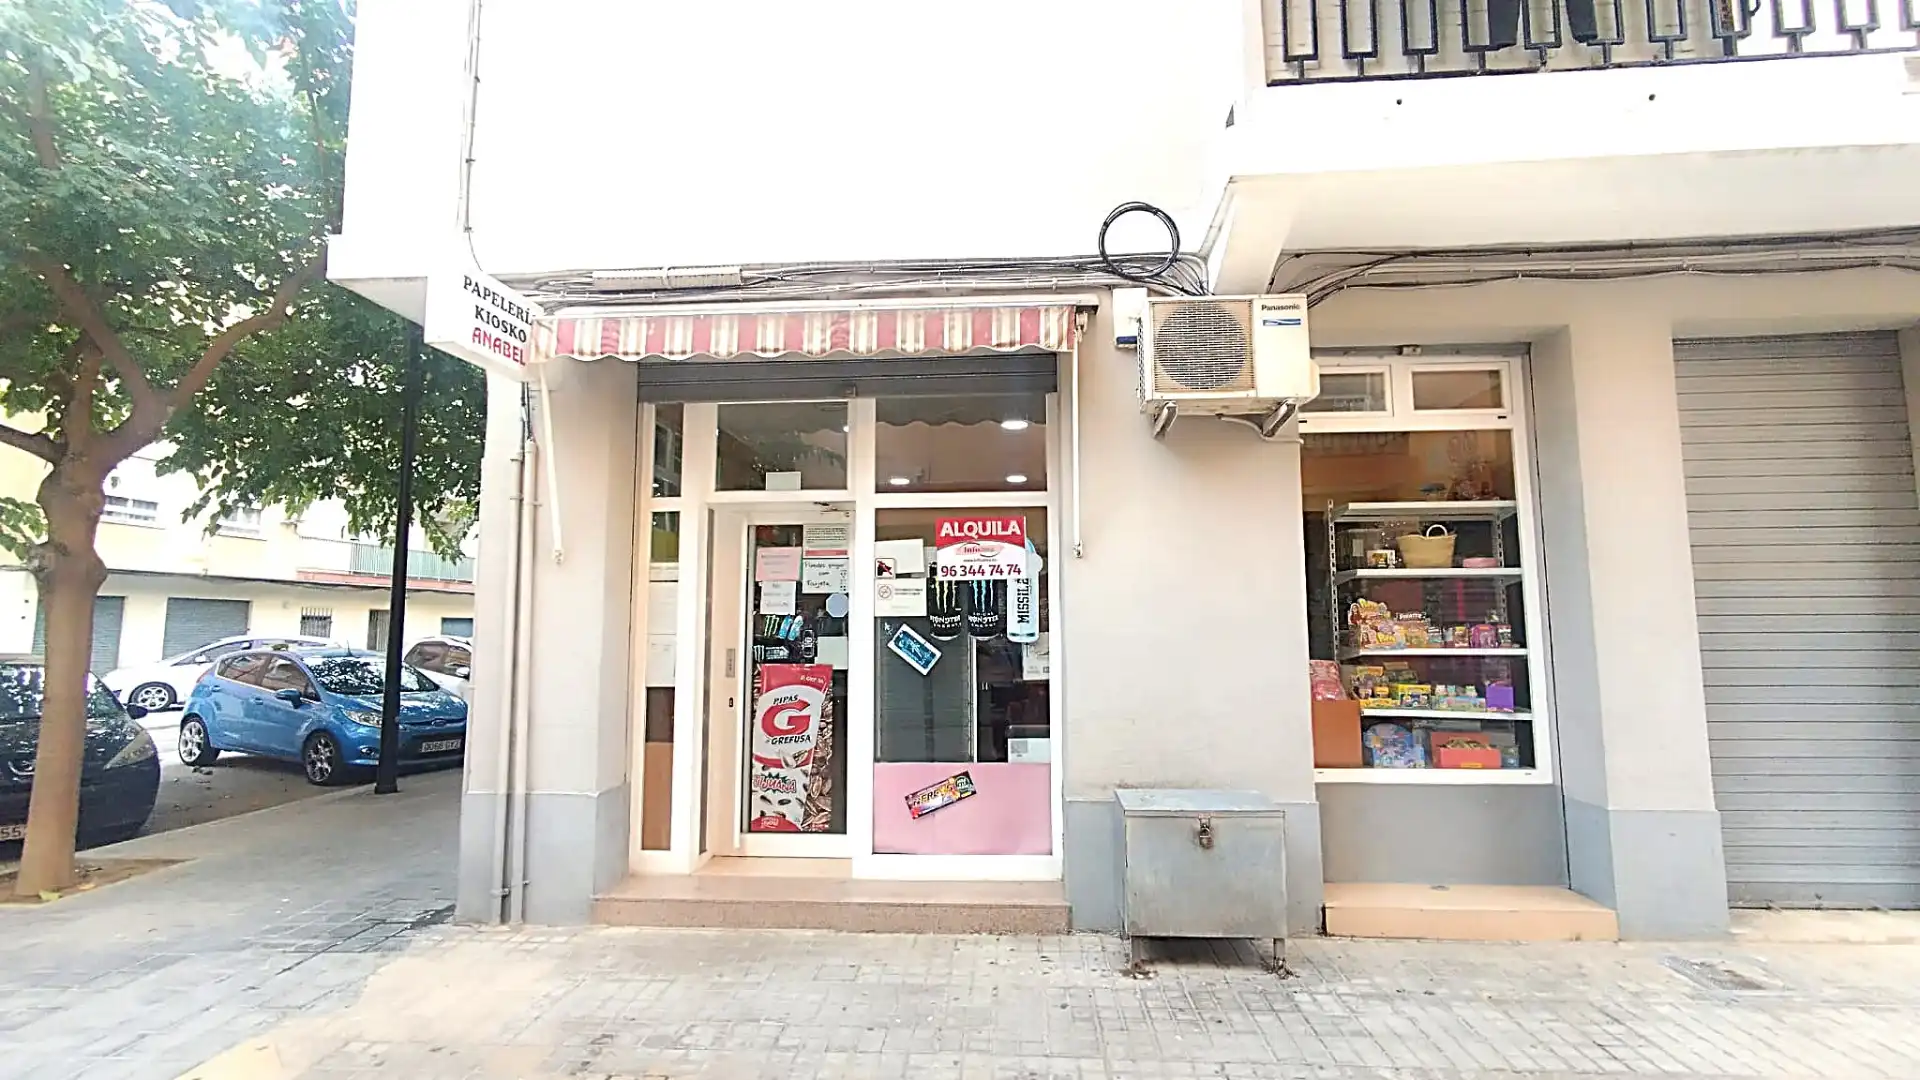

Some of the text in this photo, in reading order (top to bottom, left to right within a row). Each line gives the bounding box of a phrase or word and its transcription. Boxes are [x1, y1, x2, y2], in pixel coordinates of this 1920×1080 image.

[463, 275, 535, 326] PAPELERÍ
[475, 305, 527, 343] KIOSKO
[472, 327, 526, 366] ANABEL
[940, 520, 1021, 538] ALQUILA
[941, 563, 1022, 577] 96 344 74 74
[930, 614, 961, 624] MONSTER
[968, 614, 999, 624] MONSTER
[772, 694, 799, 705] PIPAS
[761, 699, 811, 738] G
[771, 735, 811, 745] GREFUSA
